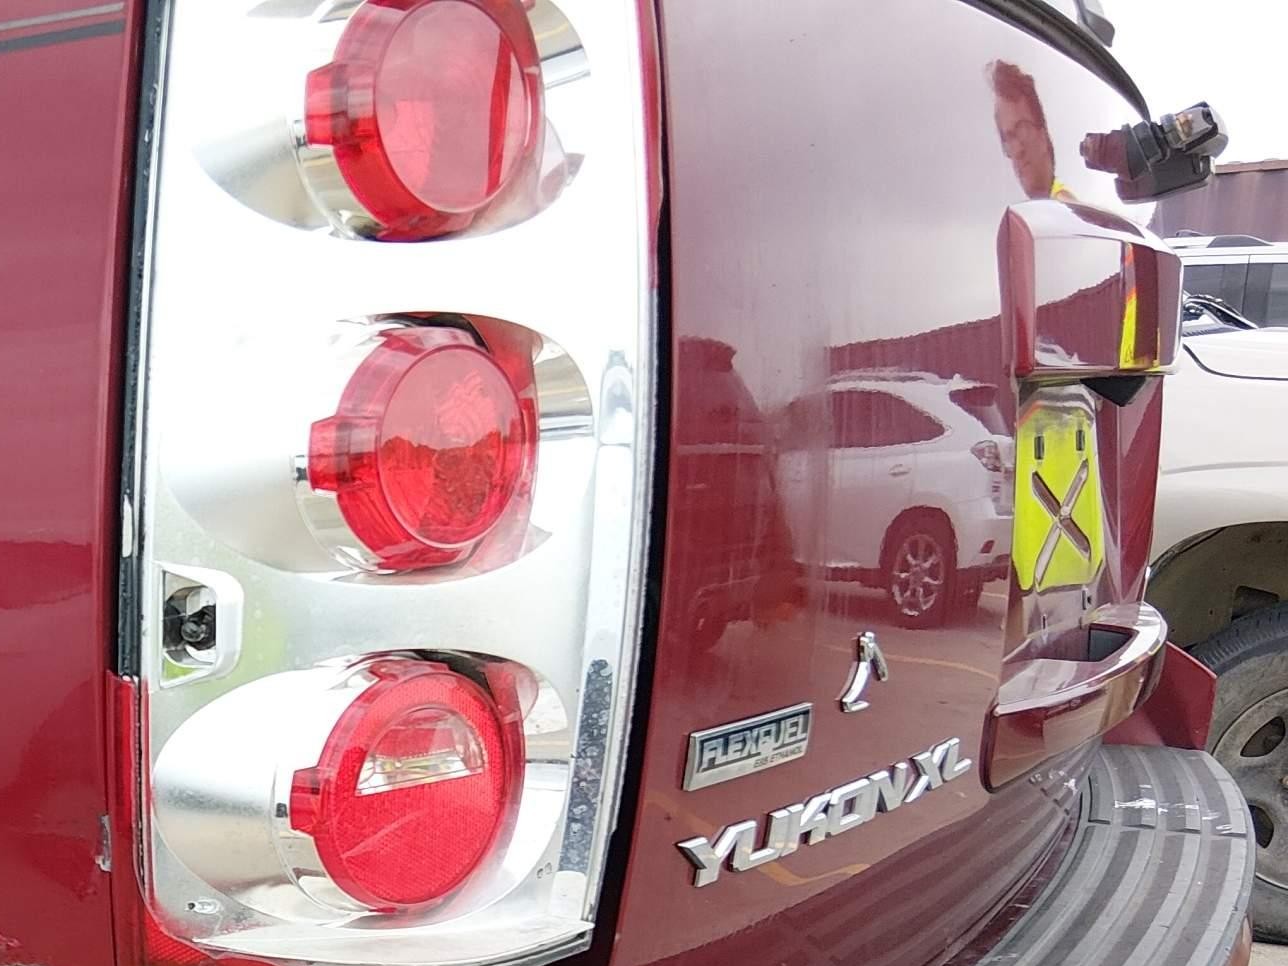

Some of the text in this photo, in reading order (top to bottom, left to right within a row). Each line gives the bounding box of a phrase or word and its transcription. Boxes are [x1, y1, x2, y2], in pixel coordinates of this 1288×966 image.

[699, 714, 808, 773] FLEXFUEL
[677, 737, 973, 888] YUKON XL
